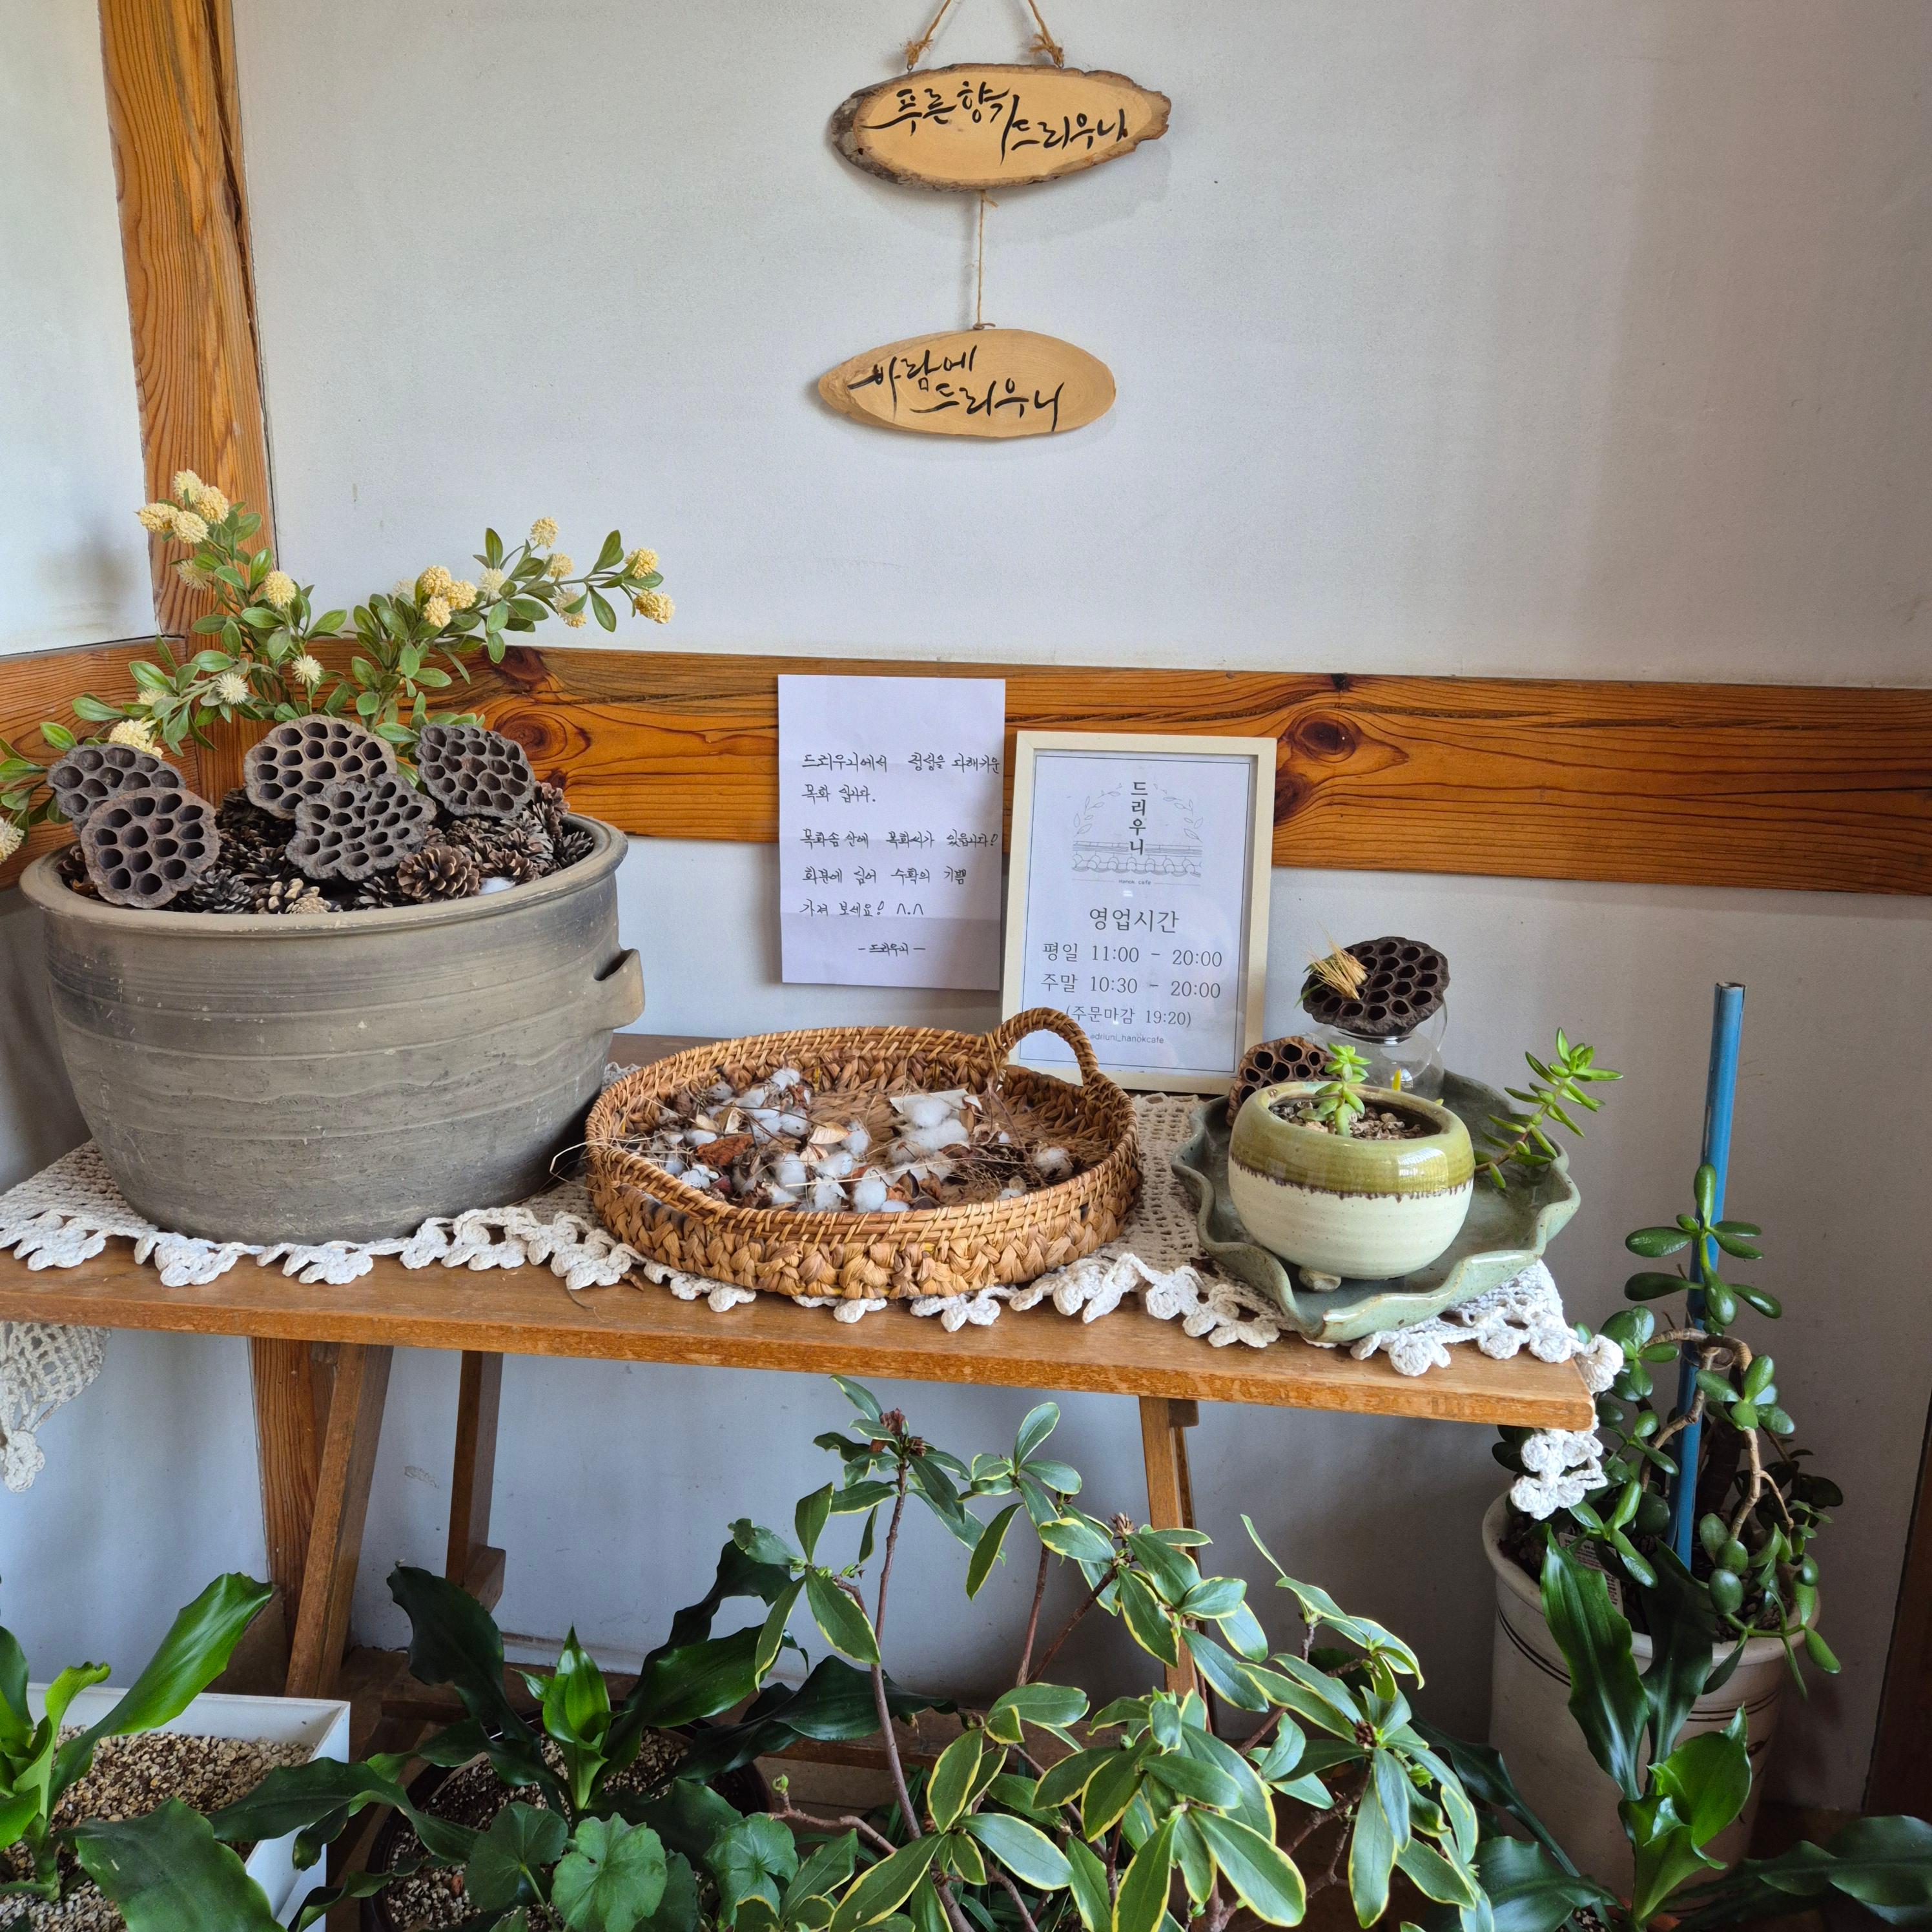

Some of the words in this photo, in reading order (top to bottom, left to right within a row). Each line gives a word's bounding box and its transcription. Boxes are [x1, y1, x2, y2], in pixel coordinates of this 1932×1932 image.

[859, 87, 957, 136] 푸른
[957, 81, 1020, 165] 향기
[847, 344, 978, 421] 바람에
[910, 378, 1065, 433] 드리우니
[908, 752, 945, 771] 정성을
[801, 784, 830, 805] 목화
[839, 784, 876, 803] 입니다.
[1128, 781, 1148, 856] 드리우니
[802, 865, 842, 885] 화분에
[854, 865, 876, 886] 심어
[890, 867, 930, 886] 수확의
[943, 865, 967, 885] 기쁨
[799, 898, 828, 917] 가져
[839, 900, 885, 918] 보세요!
[1089, 907, 1180, 934] 영업시간
[1042, 941, 1078, 962] 평일
[1092, 945, 1139, 963] 11:00
[1172, 949, 1222, 967] 20:00
[1040, 973, 1078, 994] 주말
[1091, 976, 1138, 994] 10:30
[1170, 981, 1221, 998] 20:00
[1146, 1010, 1191, 1028] 19:20)
